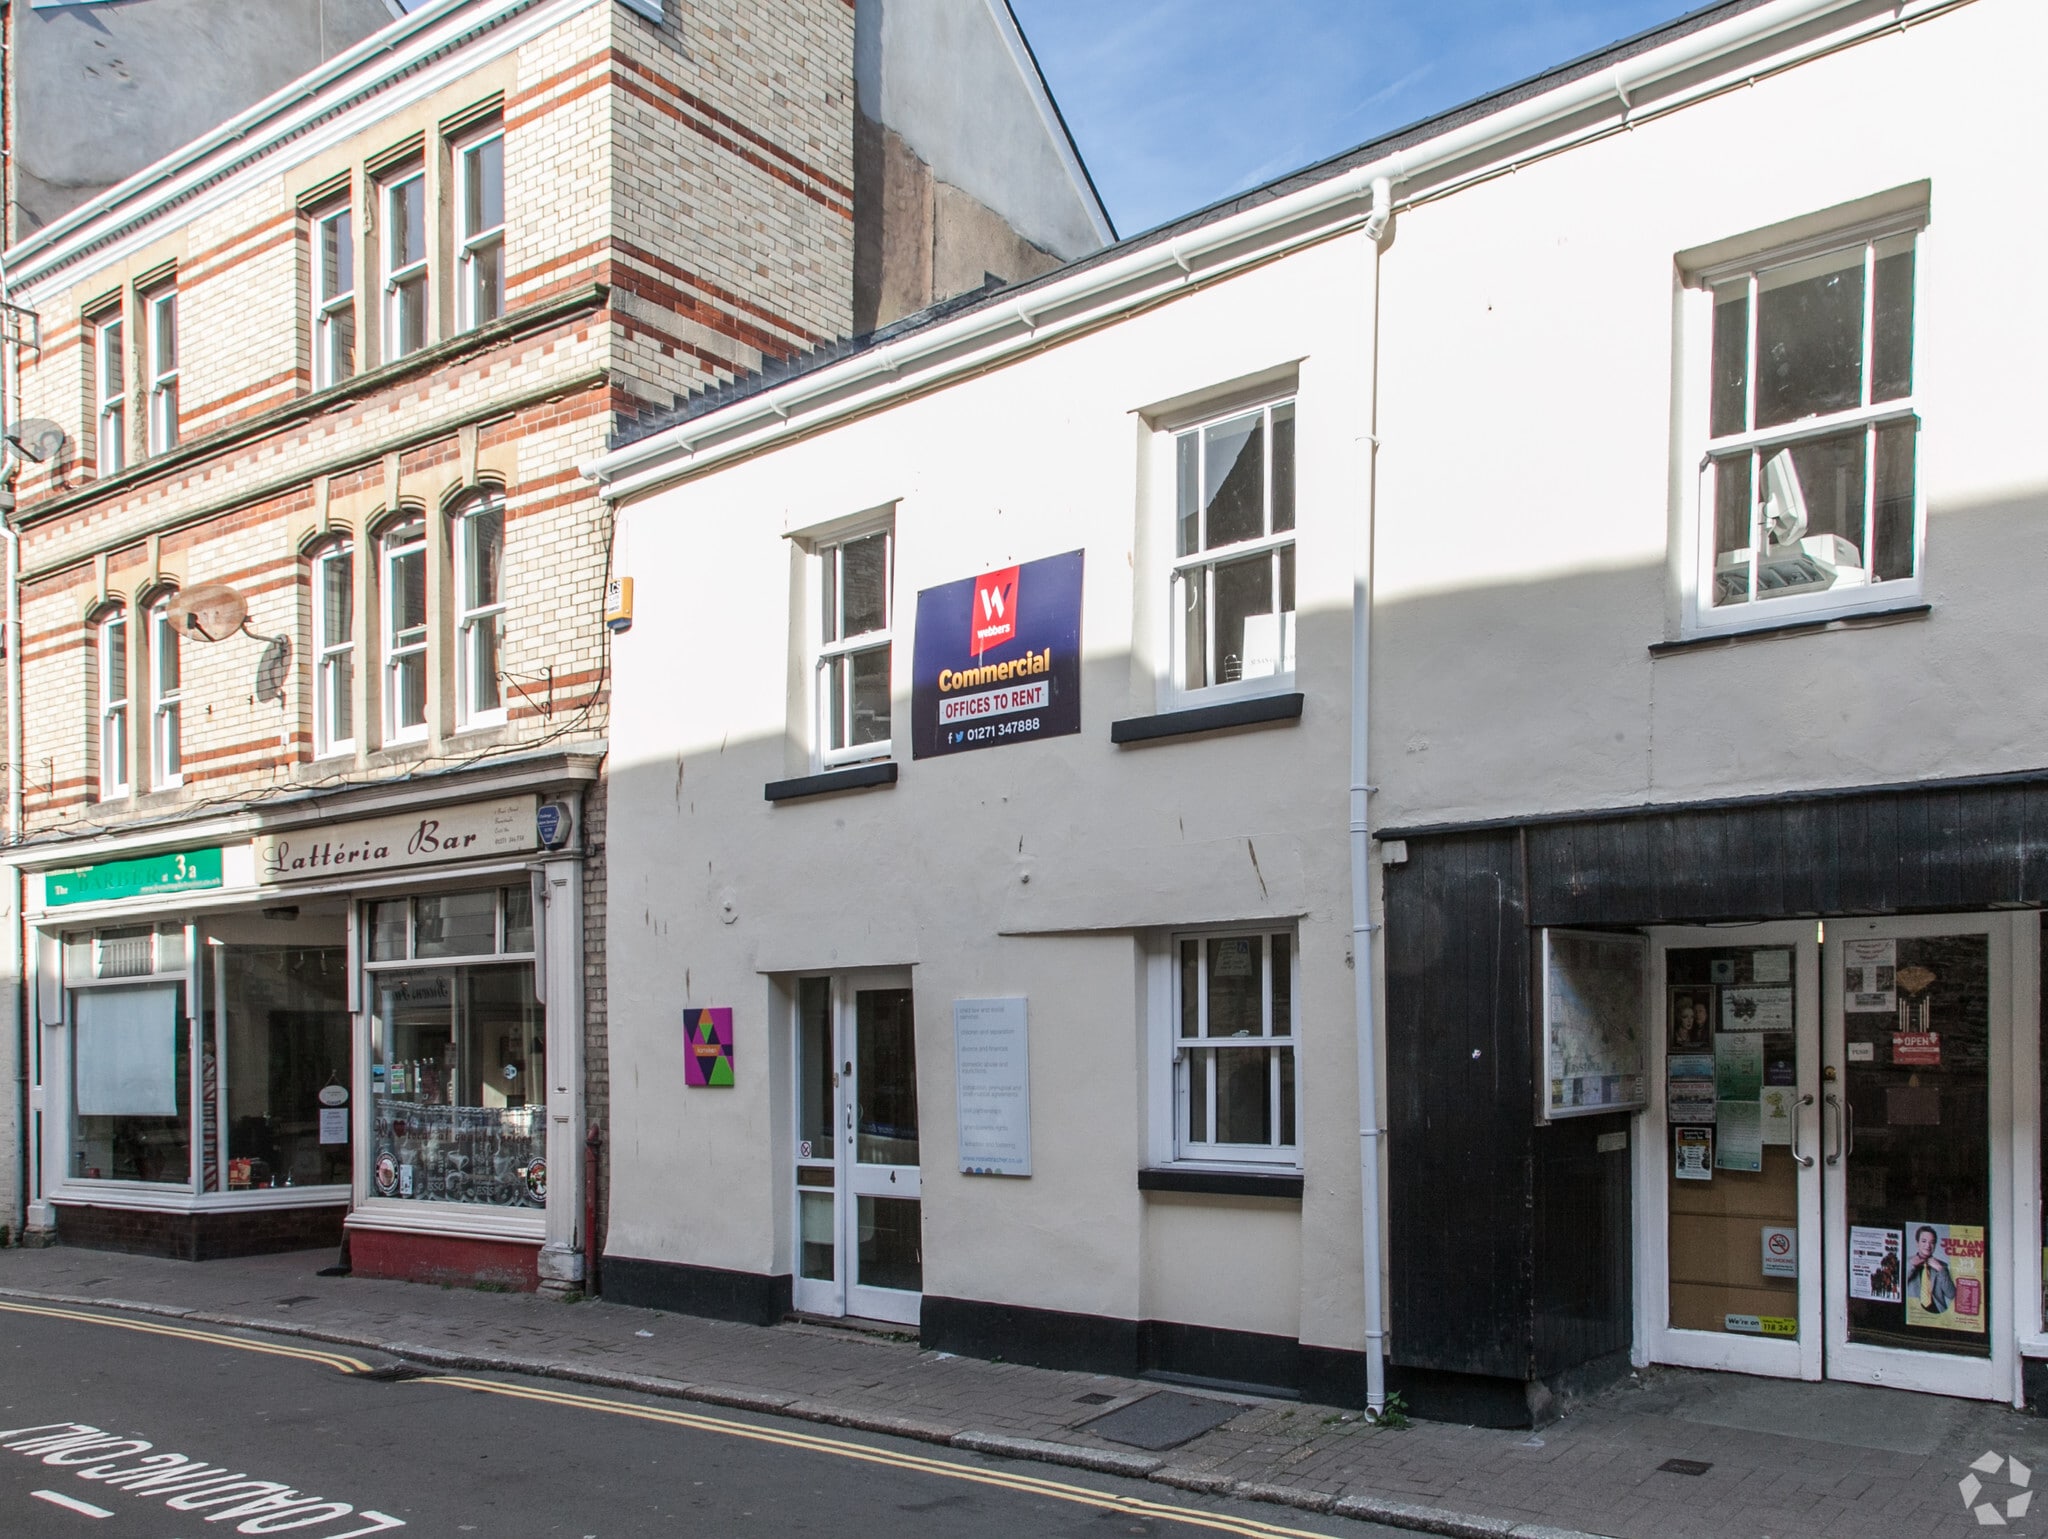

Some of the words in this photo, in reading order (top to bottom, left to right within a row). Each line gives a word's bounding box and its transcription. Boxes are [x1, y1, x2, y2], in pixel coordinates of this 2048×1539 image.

[977, 623, 1011, 639] webbers
[938, 647, 1051, 692] Commercial
[945, 696, 990, 719] OFFICES
[993, 693, 1009, 711] TO
[1011, 686, 1042, 706] RENT
[967, 725, 996, 741] 01271
[997, 717, 1041, 736] 347888
[262, 840, 390, 876] Lattéria
[408, 818, 477, 856] Bar
[54, 885, 69, 896] The
[1903, 1036, 1929, 1046] OPEN
[889, 1170, 897, 1184] 4
[1941, 1237, 1985, 1249] JULIAN
[1944, 1246, 1985, 1259] CLARY
[1728, 1318, 1749, 1326] We're
[75, 1453, 407, 1539] LOADING
